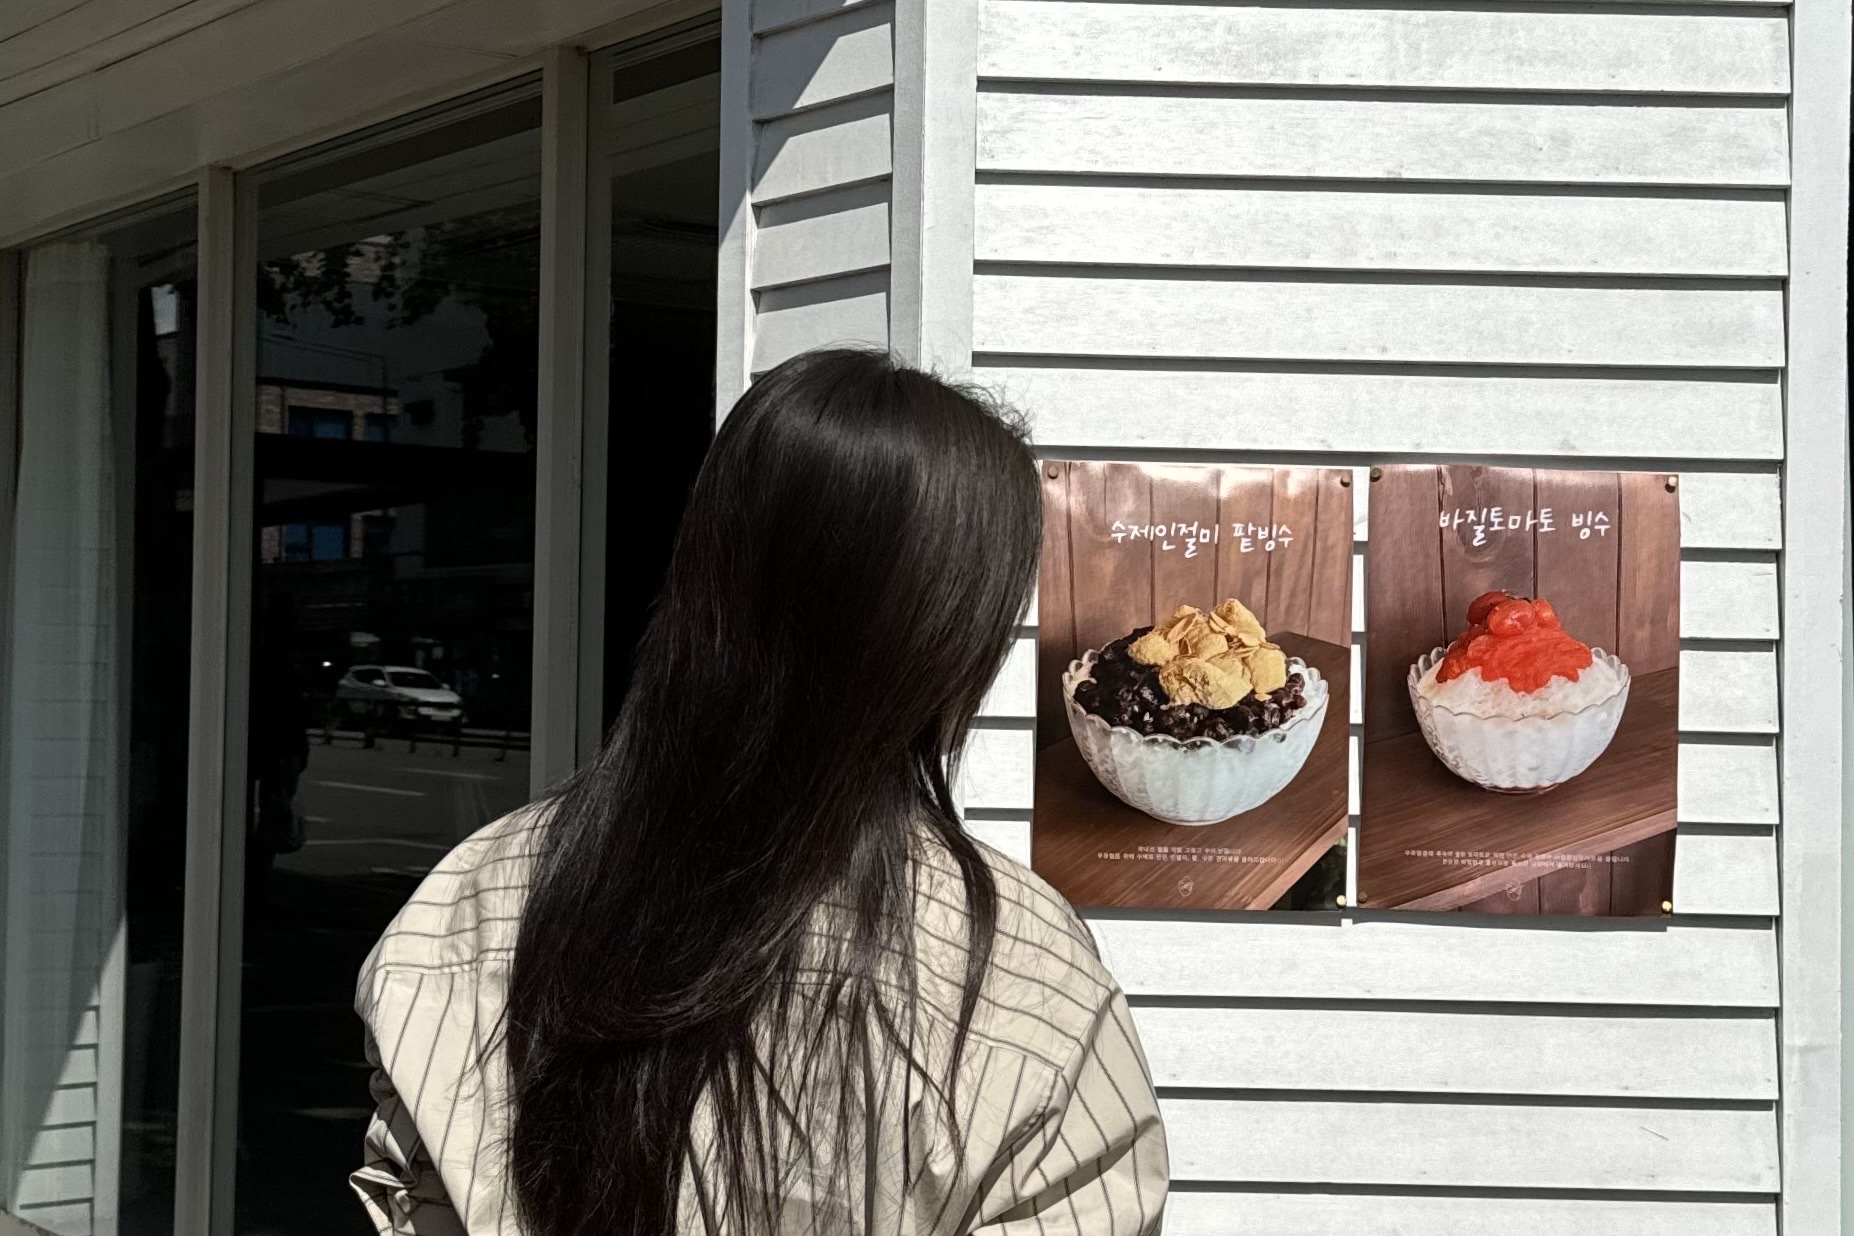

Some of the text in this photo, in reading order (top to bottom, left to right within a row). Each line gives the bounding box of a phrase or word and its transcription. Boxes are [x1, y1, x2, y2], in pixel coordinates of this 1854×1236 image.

[1110, 520, 1294, 558] 수제인절미 팥빙수
[1439, 507, 1610, 547] 바질토마토 빙수
